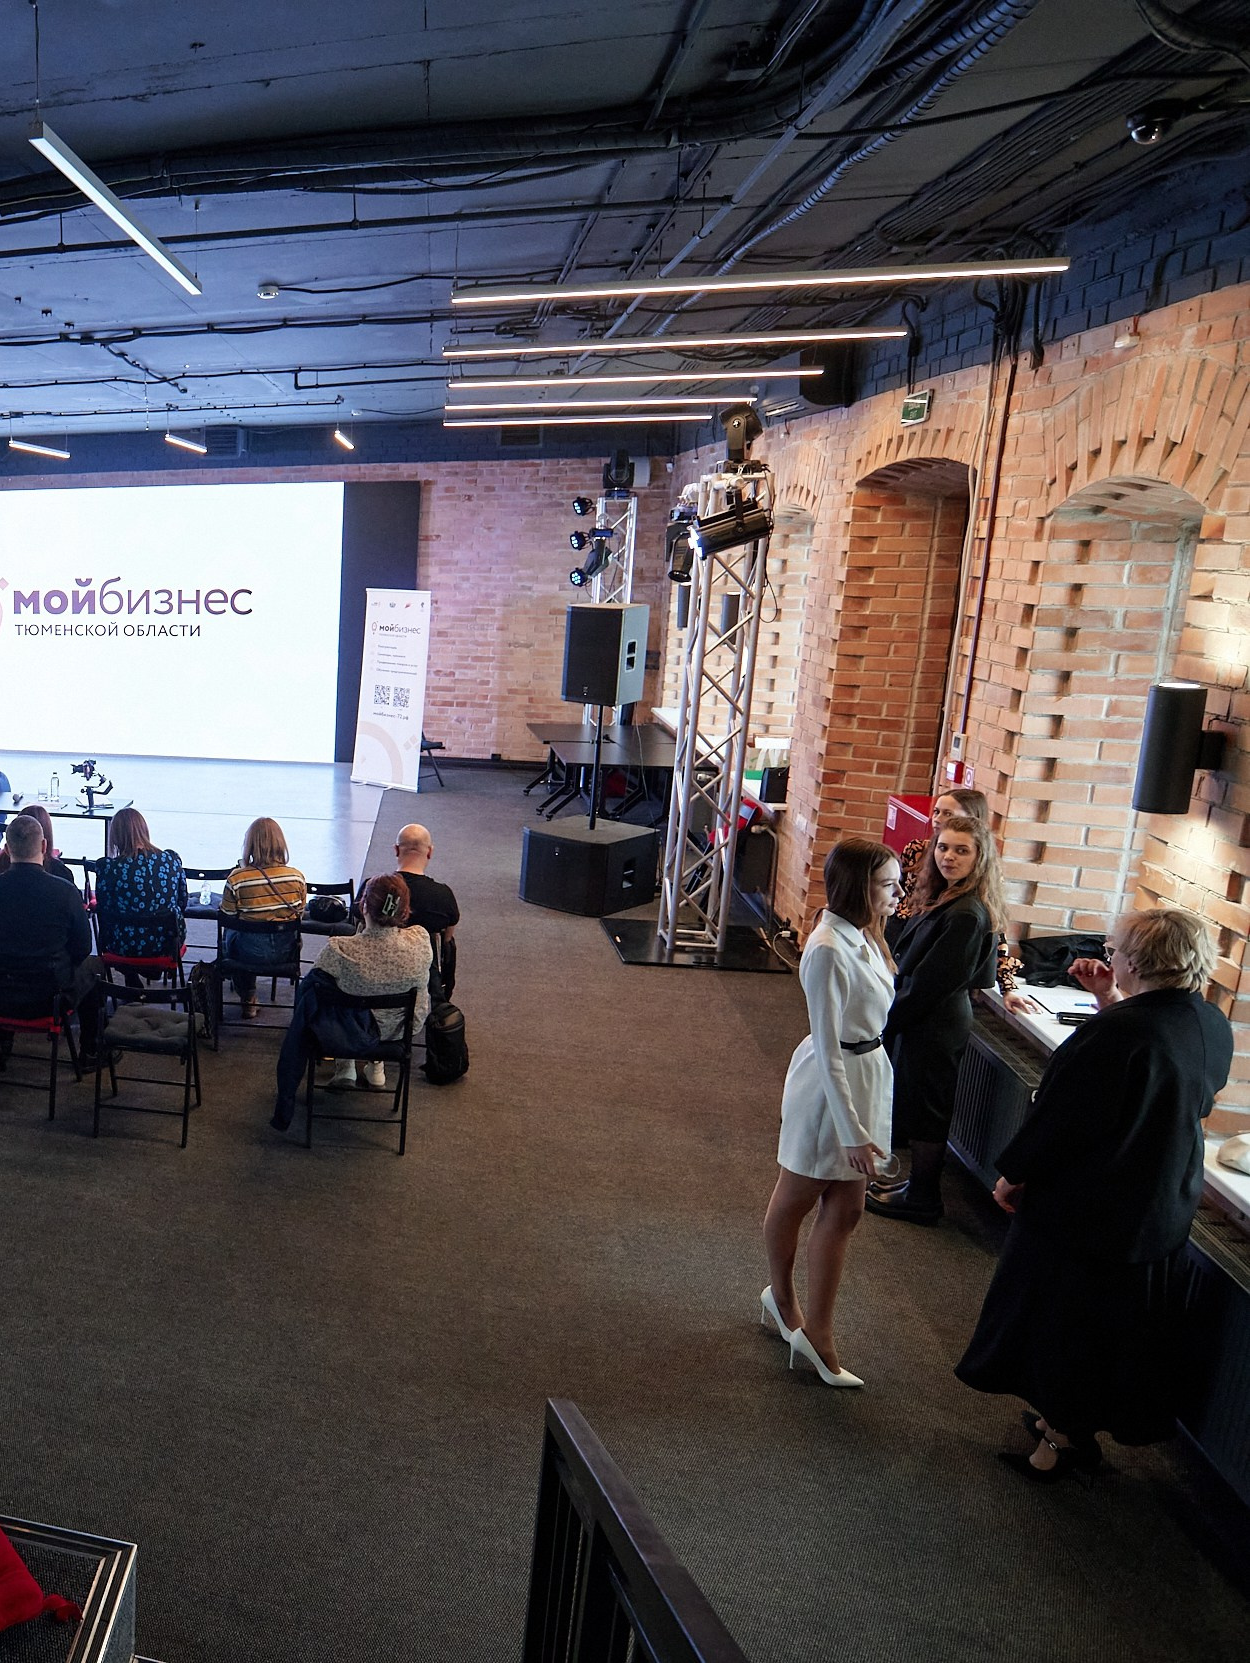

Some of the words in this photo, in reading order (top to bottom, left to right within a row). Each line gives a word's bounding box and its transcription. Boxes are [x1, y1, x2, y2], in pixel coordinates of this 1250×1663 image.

[13, 576, 253, 615] мойбизнес
[15, 621, 119, 637] ТЮМЕНСКОЙ
[123, 624, 200, 637] ОБЛАСТИ
